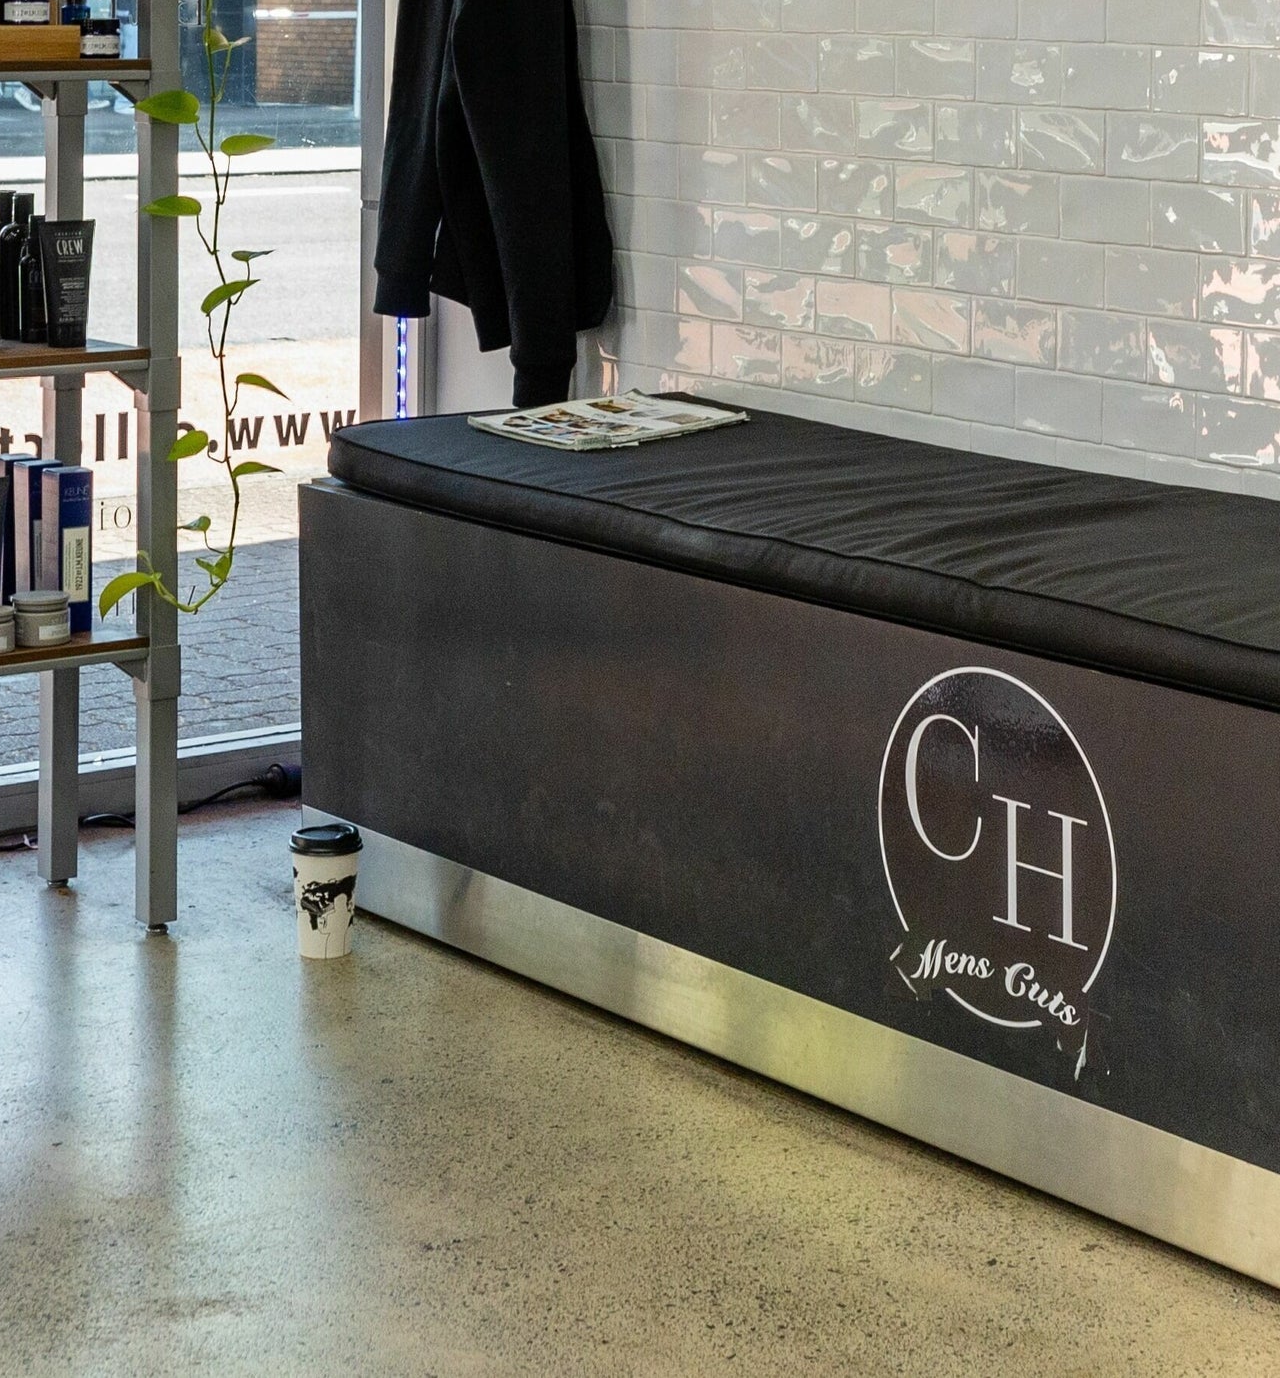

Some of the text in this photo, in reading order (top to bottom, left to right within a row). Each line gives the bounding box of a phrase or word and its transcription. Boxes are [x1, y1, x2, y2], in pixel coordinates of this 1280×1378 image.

[56, 238, 83, 256] CREW
[911, 938, 1081, 1027] Mens Cuts
